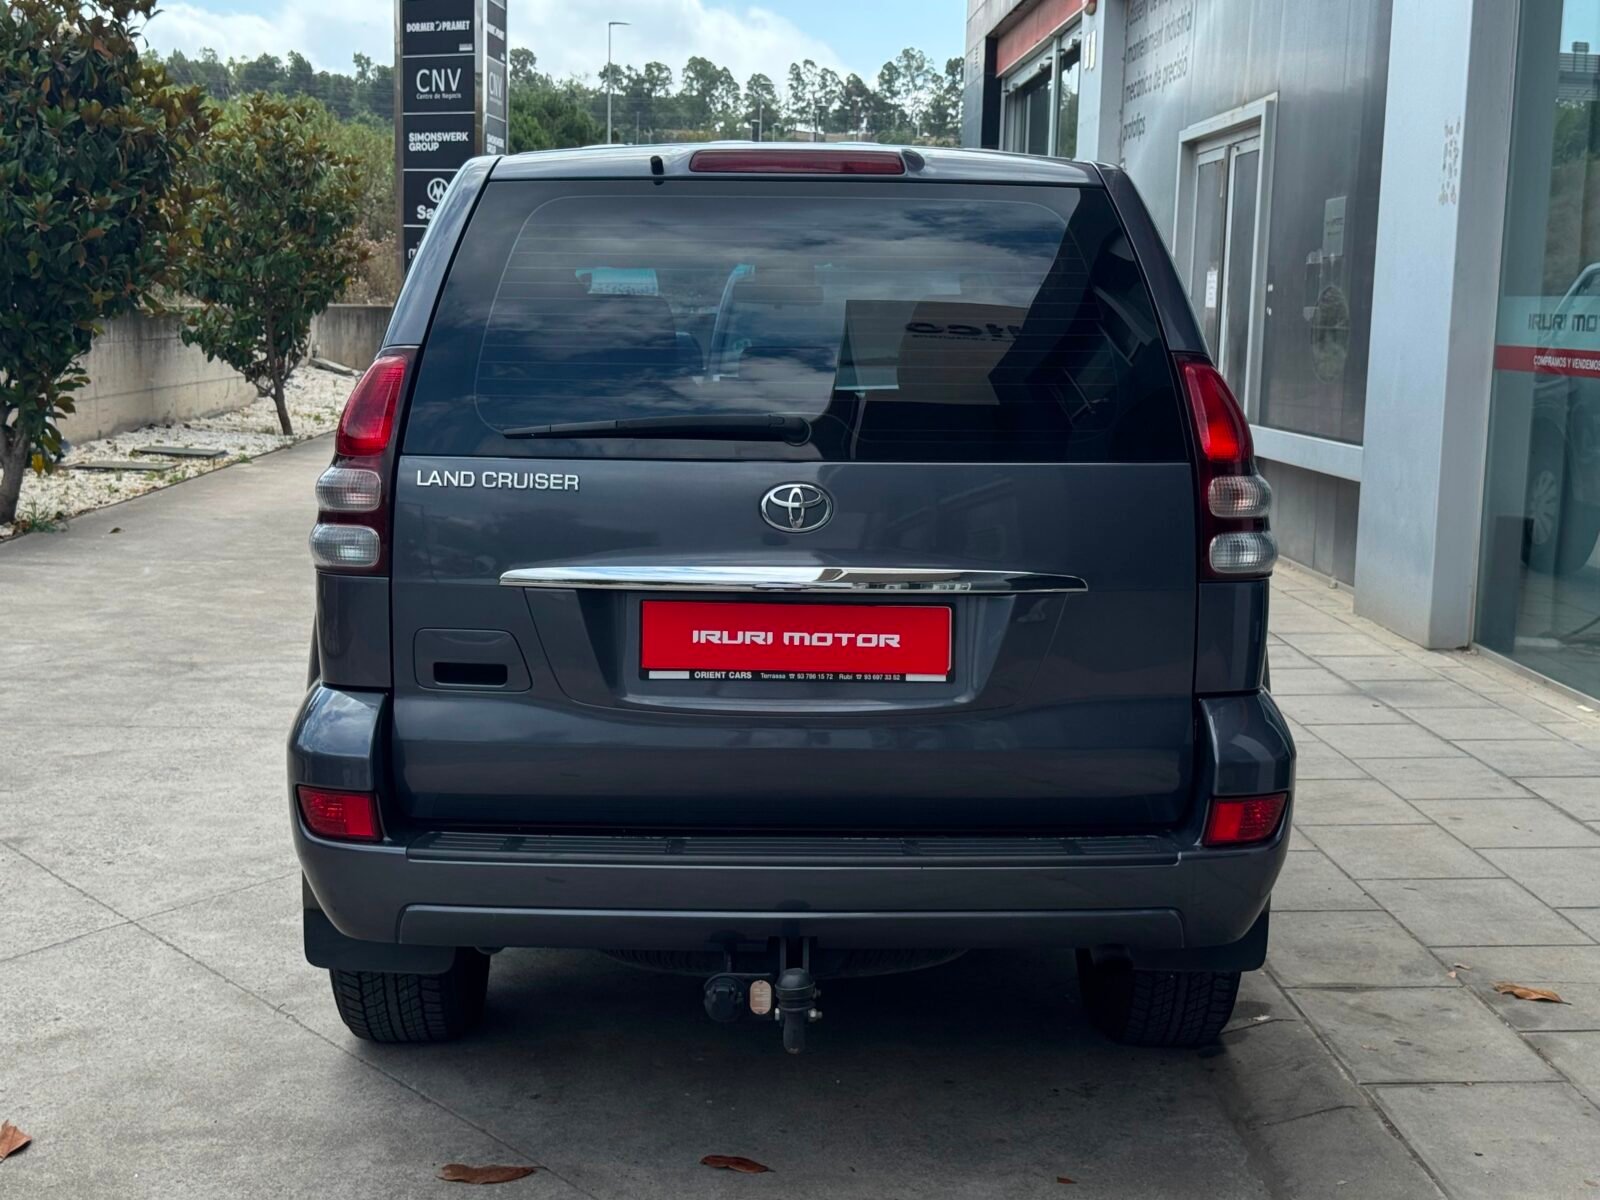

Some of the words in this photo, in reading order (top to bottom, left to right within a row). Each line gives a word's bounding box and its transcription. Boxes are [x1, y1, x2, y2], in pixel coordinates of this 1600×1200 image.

[406, 22, 435, 32] DORMER
[442, 20, 470, 31] PRAMET
[416, 67, 461, 93] CNV
[408, 131, 469, 143] SIMONSWERK
[408, 142, 440, 151] GROUP
[1528, 313, 1567, 330] IRURI
[1571, 314, 1600, 332] MO
[1534, 355, 1566, 368] COMPRAMOS
[416, 470, 476, 487] LAND
[482, 471, 580, 491] CRUISER
[692, 630, 774, 645] IRURI
[783, 632, 901, 648] MOTOR
[694, 671, 727, 679] ORIENT
[728, 671, 752, 679] CARS
